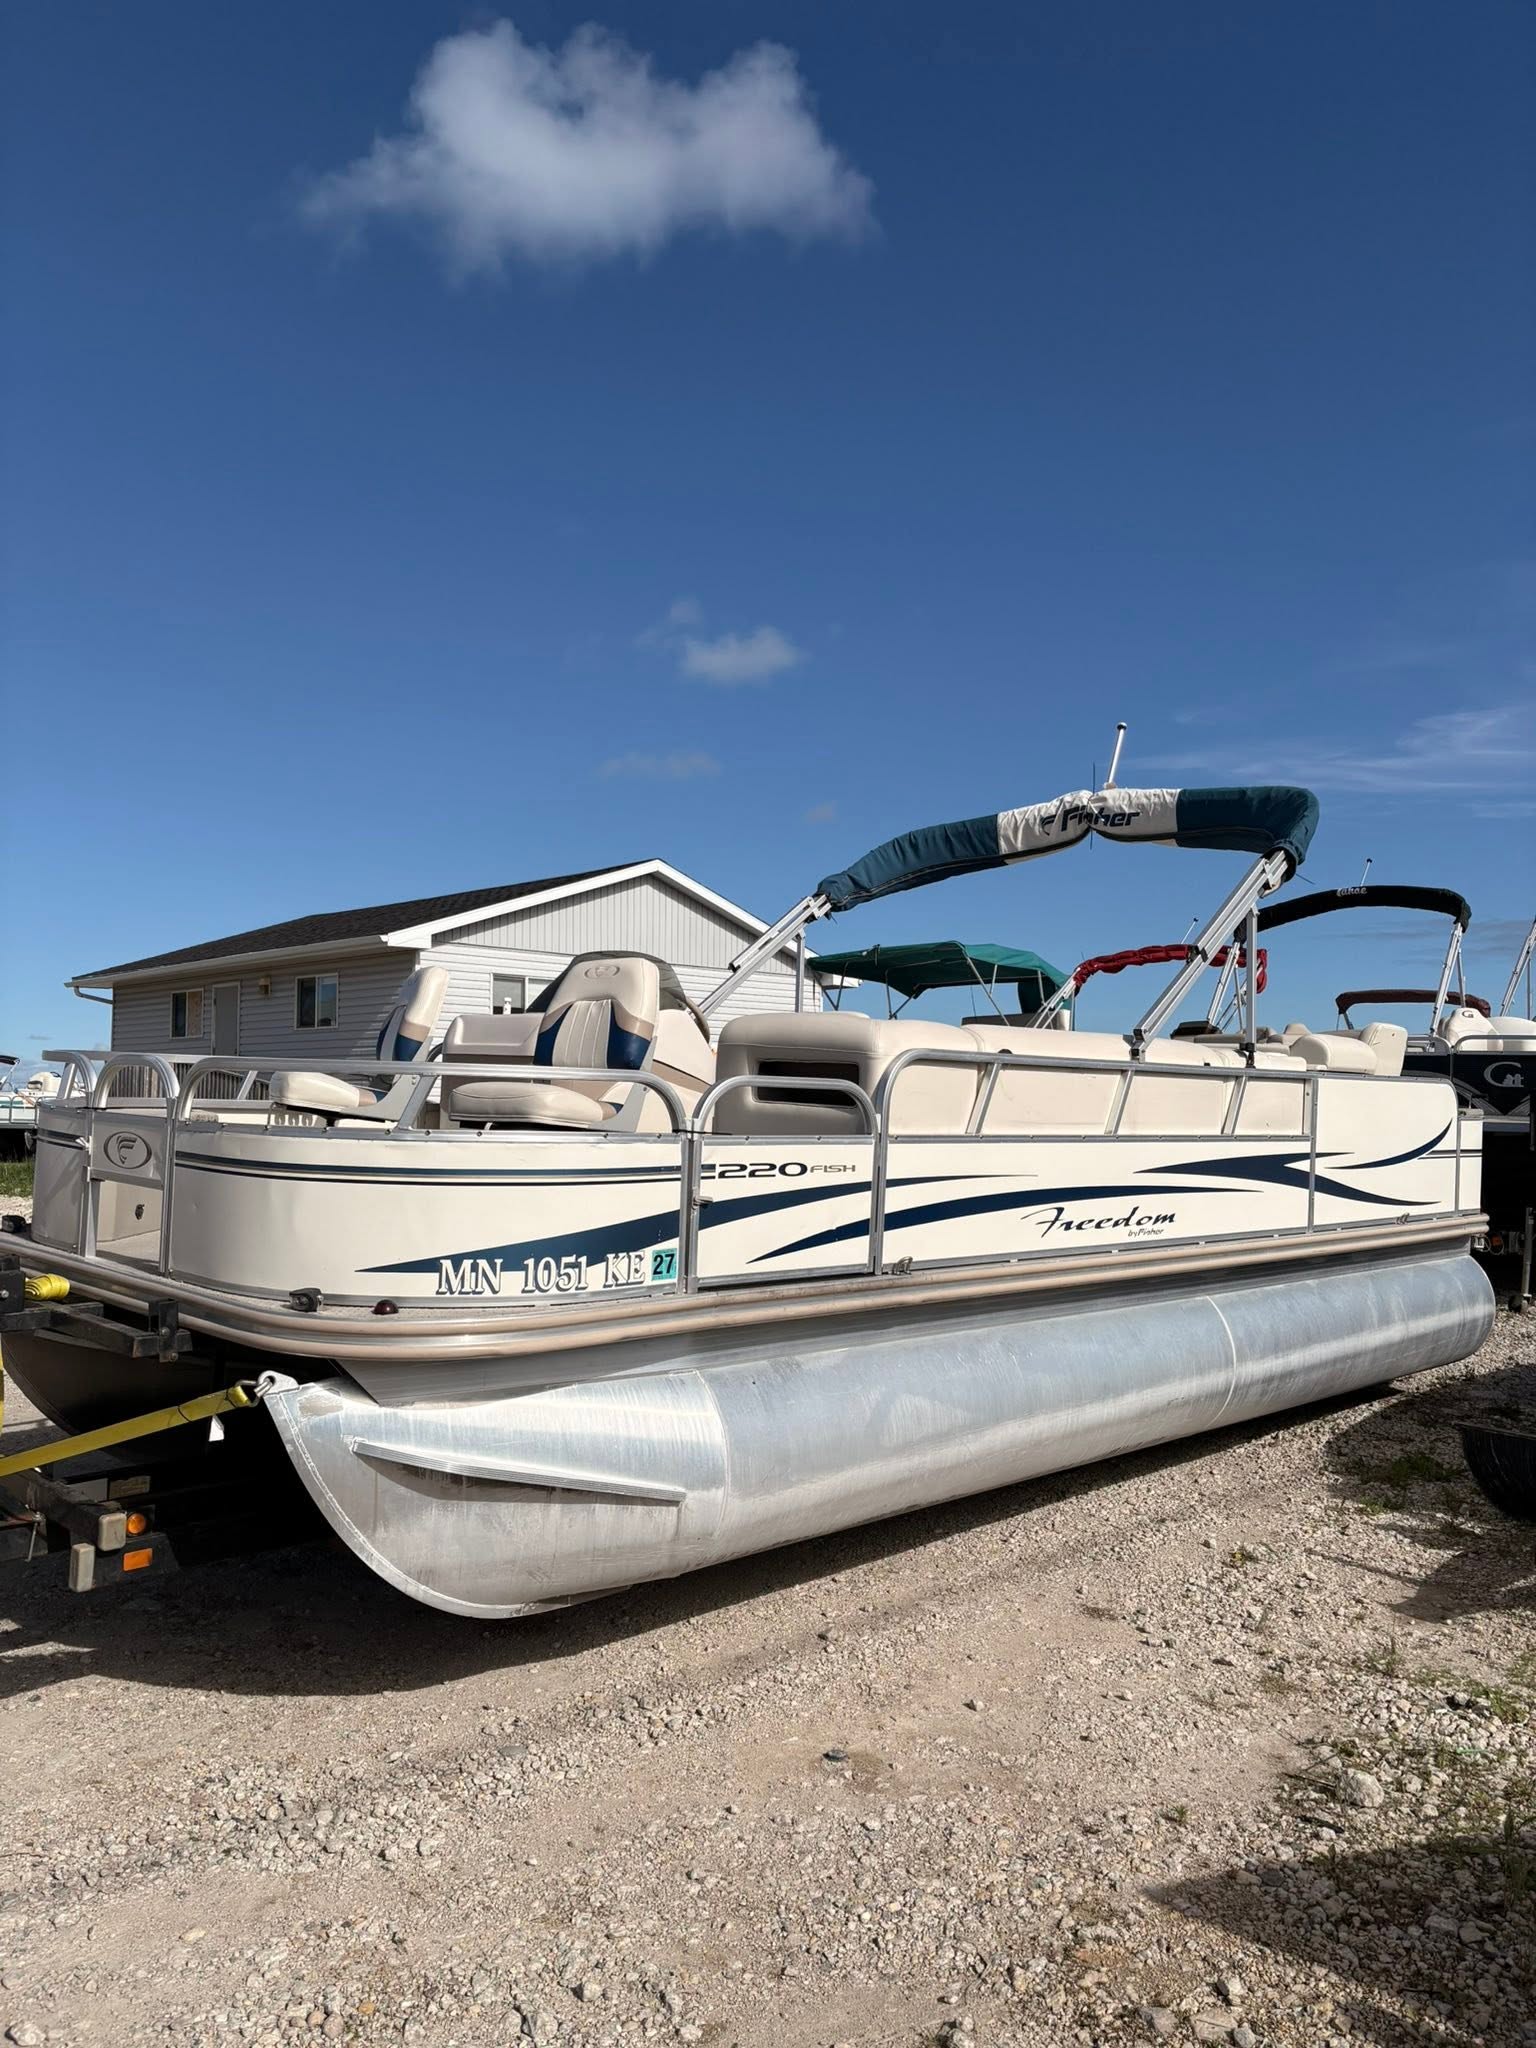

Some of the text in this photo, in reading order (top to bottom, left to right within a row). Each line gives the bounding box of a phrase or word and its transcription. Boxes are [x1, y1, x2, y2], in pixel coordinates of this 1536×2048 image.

[717, 1162, 857, 1179] 220 FISH
[1020, 1205, 1176, 1239] Freedom
[436, 1250, 646, 1295] MN 1051 KE
[653, 1253, 675, 1276] 27
